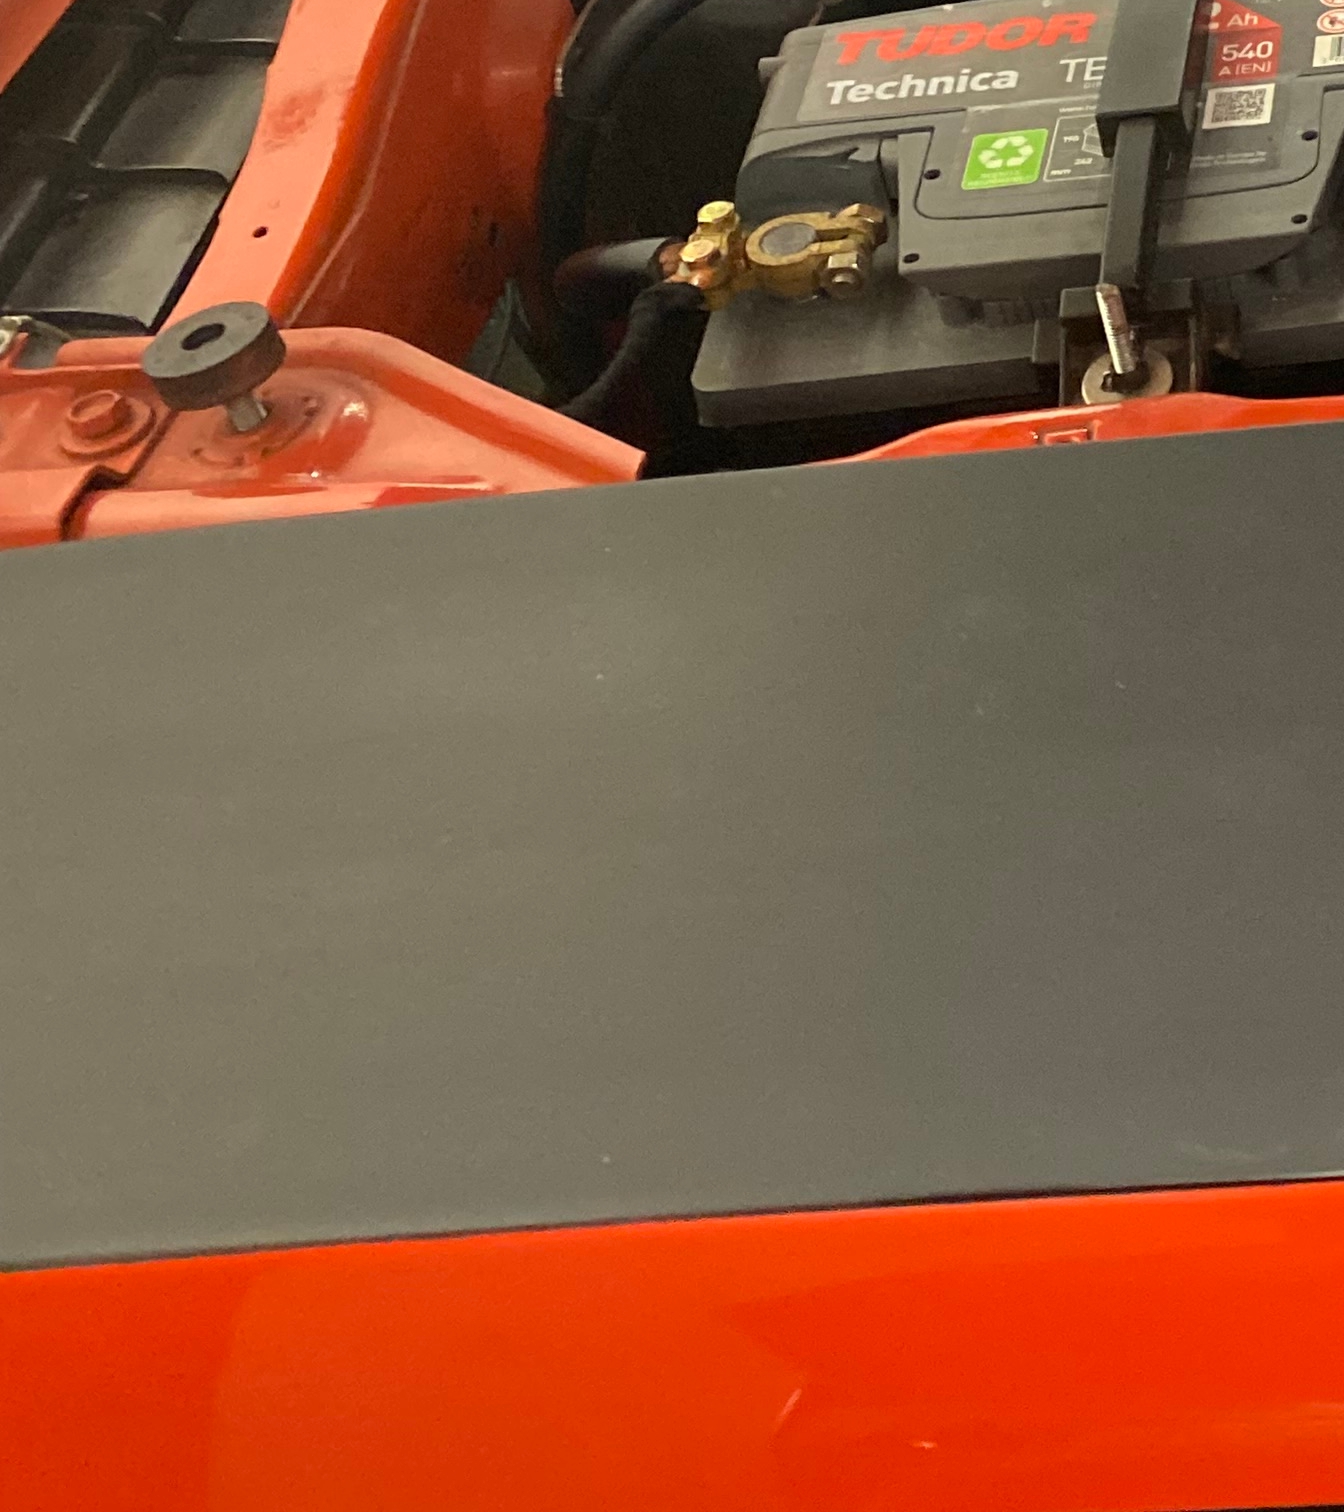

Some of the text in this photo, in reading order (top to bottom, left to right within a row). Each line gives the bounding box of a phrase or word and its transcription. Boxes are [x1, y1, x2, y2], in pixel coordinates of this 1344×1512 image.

[1227, 13, 1259, 27] Ah
[836, 12, 1097, 66] TUDOR
[1221, 40, 1274, 62] 540
[1218, 66, 1232, 77] A
[826, 67, 1019, 105] Technica
